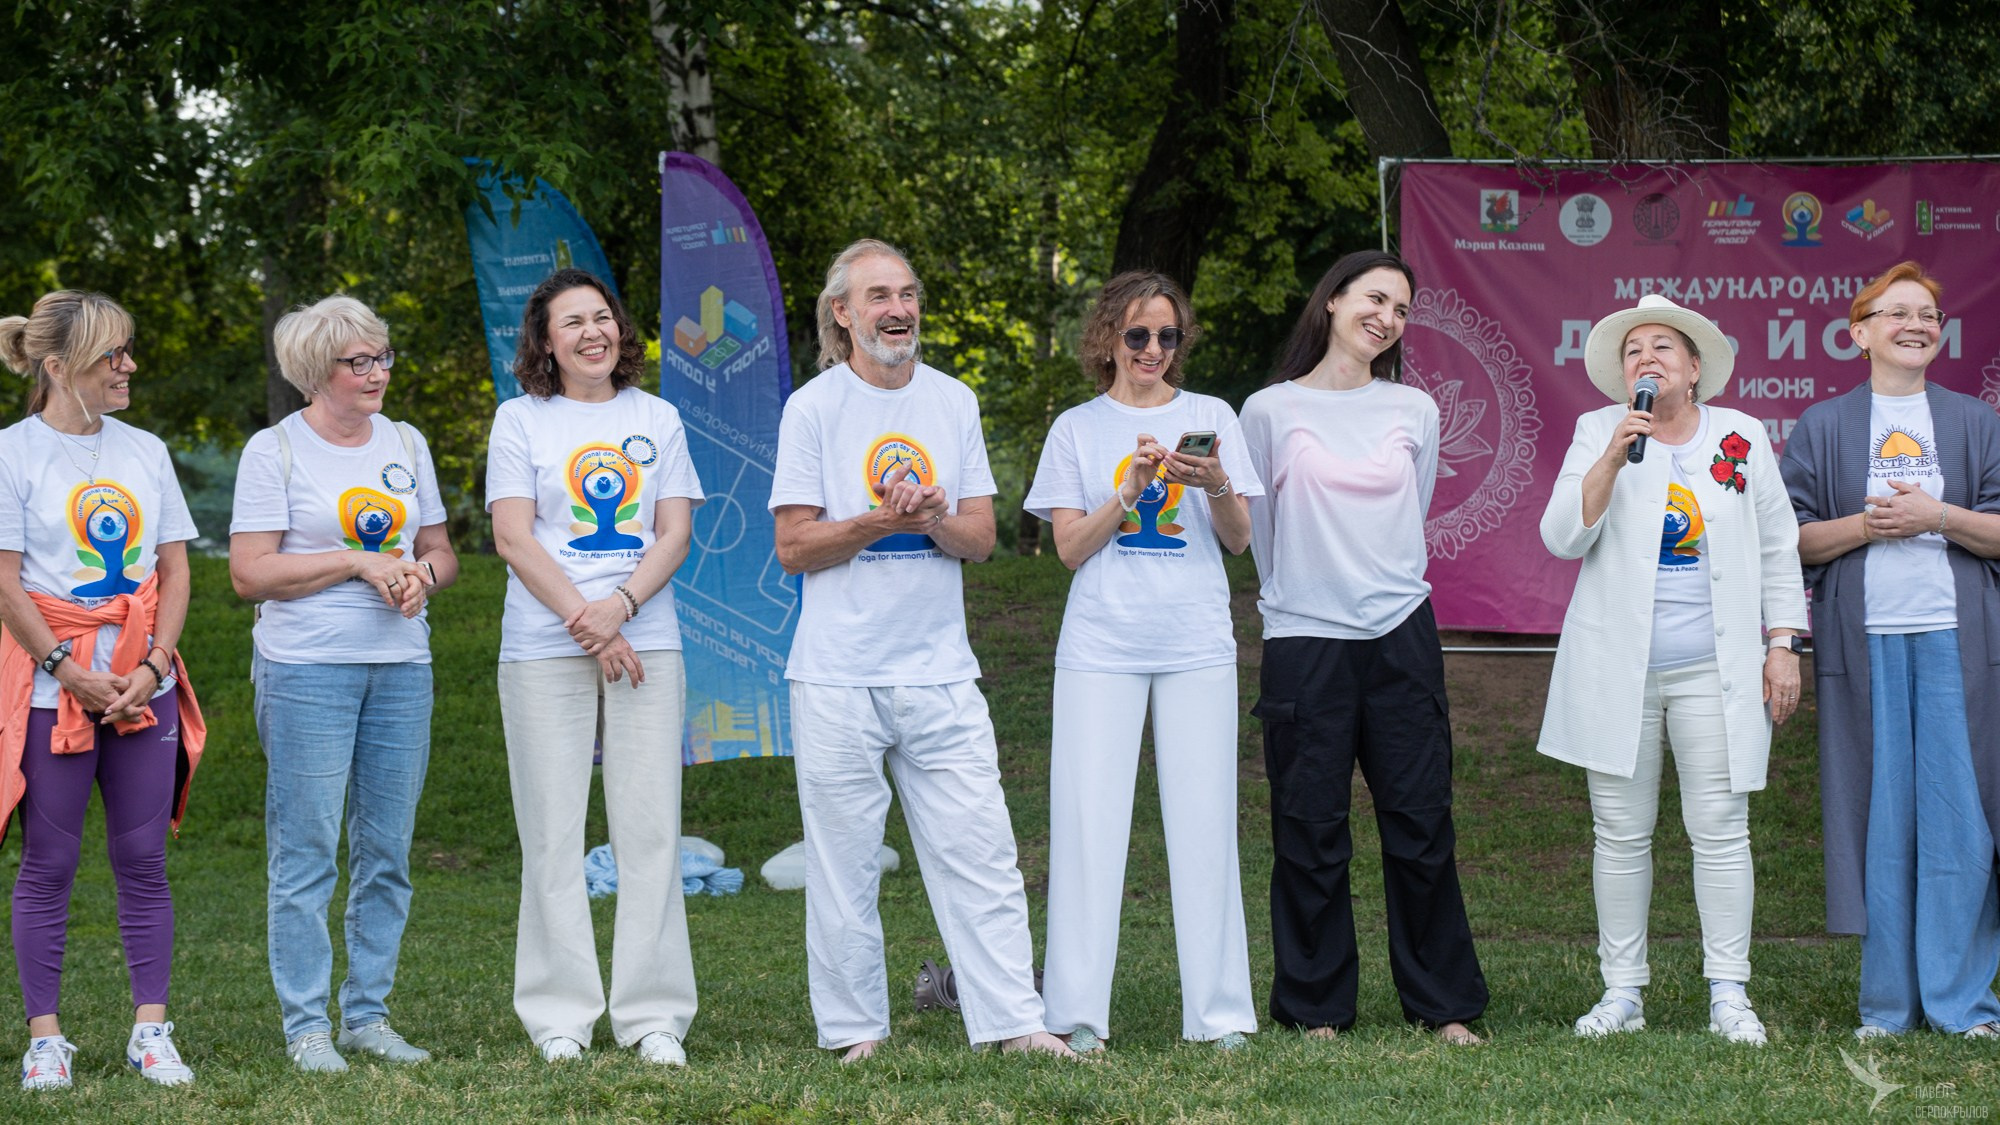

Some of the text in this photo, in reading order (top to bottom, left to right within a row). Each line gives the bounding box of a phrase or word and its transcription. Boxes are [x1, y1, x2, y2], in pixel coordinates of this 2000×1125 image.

[1454, 239, 1545, 252] Мэрия Казани
[1614, 276, 1874, 305] МЕЖДУНАРОДН
[1768, 308, 1962, 361] ЙОИ
[1739, 377, 1815, 399] ИЮНЯ
[574, 451, 601, 478] International
[623, 461, 633, 476] yoga
[873, 442, 899, 476] International
[900, 443, 910, 452] day
[917, 457, 928, 474] yoga
[78, 487, 101, 519] International
[102, 487, 116, 495] day
[124, 500, 136, 517] yoga
[559, 549, 576, 557] Yoga
[590, 551, 625, 559] Harmony
[891, 552, 926, 560] Harmony
